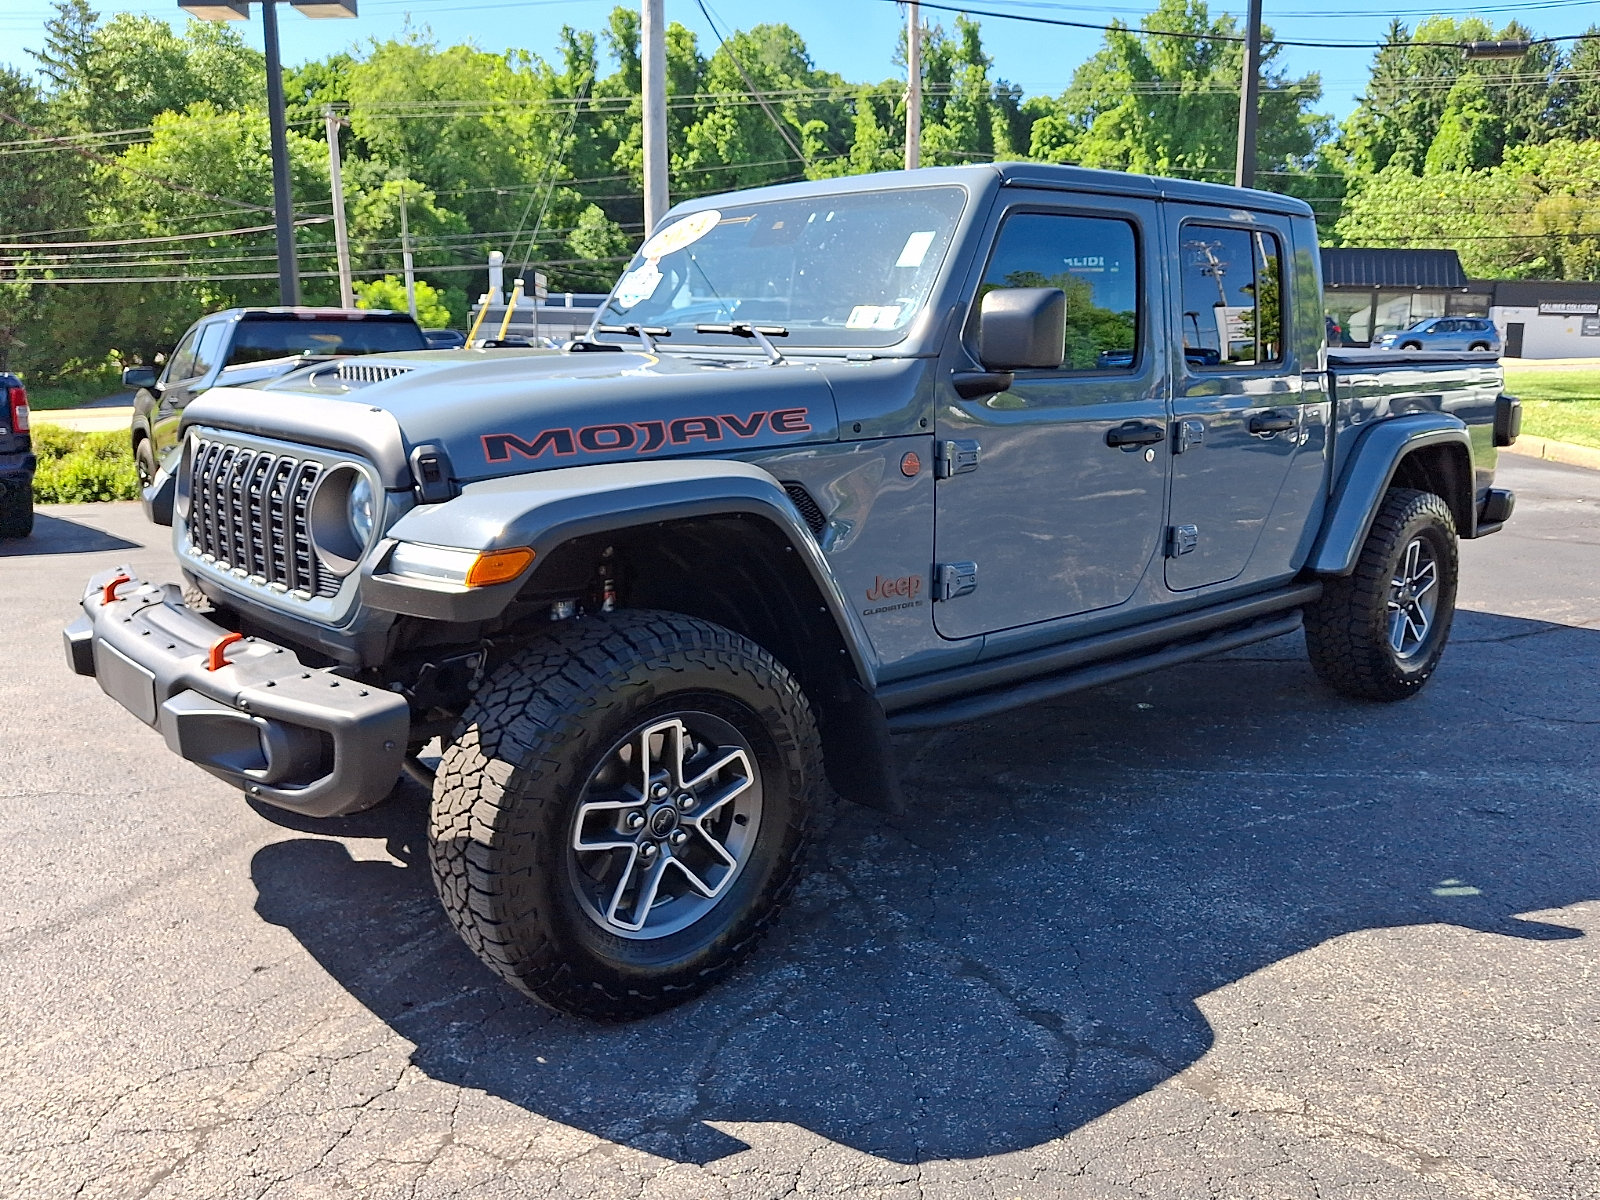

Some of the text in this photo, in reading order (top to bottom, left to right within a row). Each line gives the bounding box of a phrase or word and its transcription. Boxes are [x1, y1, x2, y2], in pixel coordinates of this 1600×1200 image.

[480, 407, 811, 463] MOJAVE
[866, 574, 922, 601] Jeep
[863, 601, 915, 616] GLADIATOR
